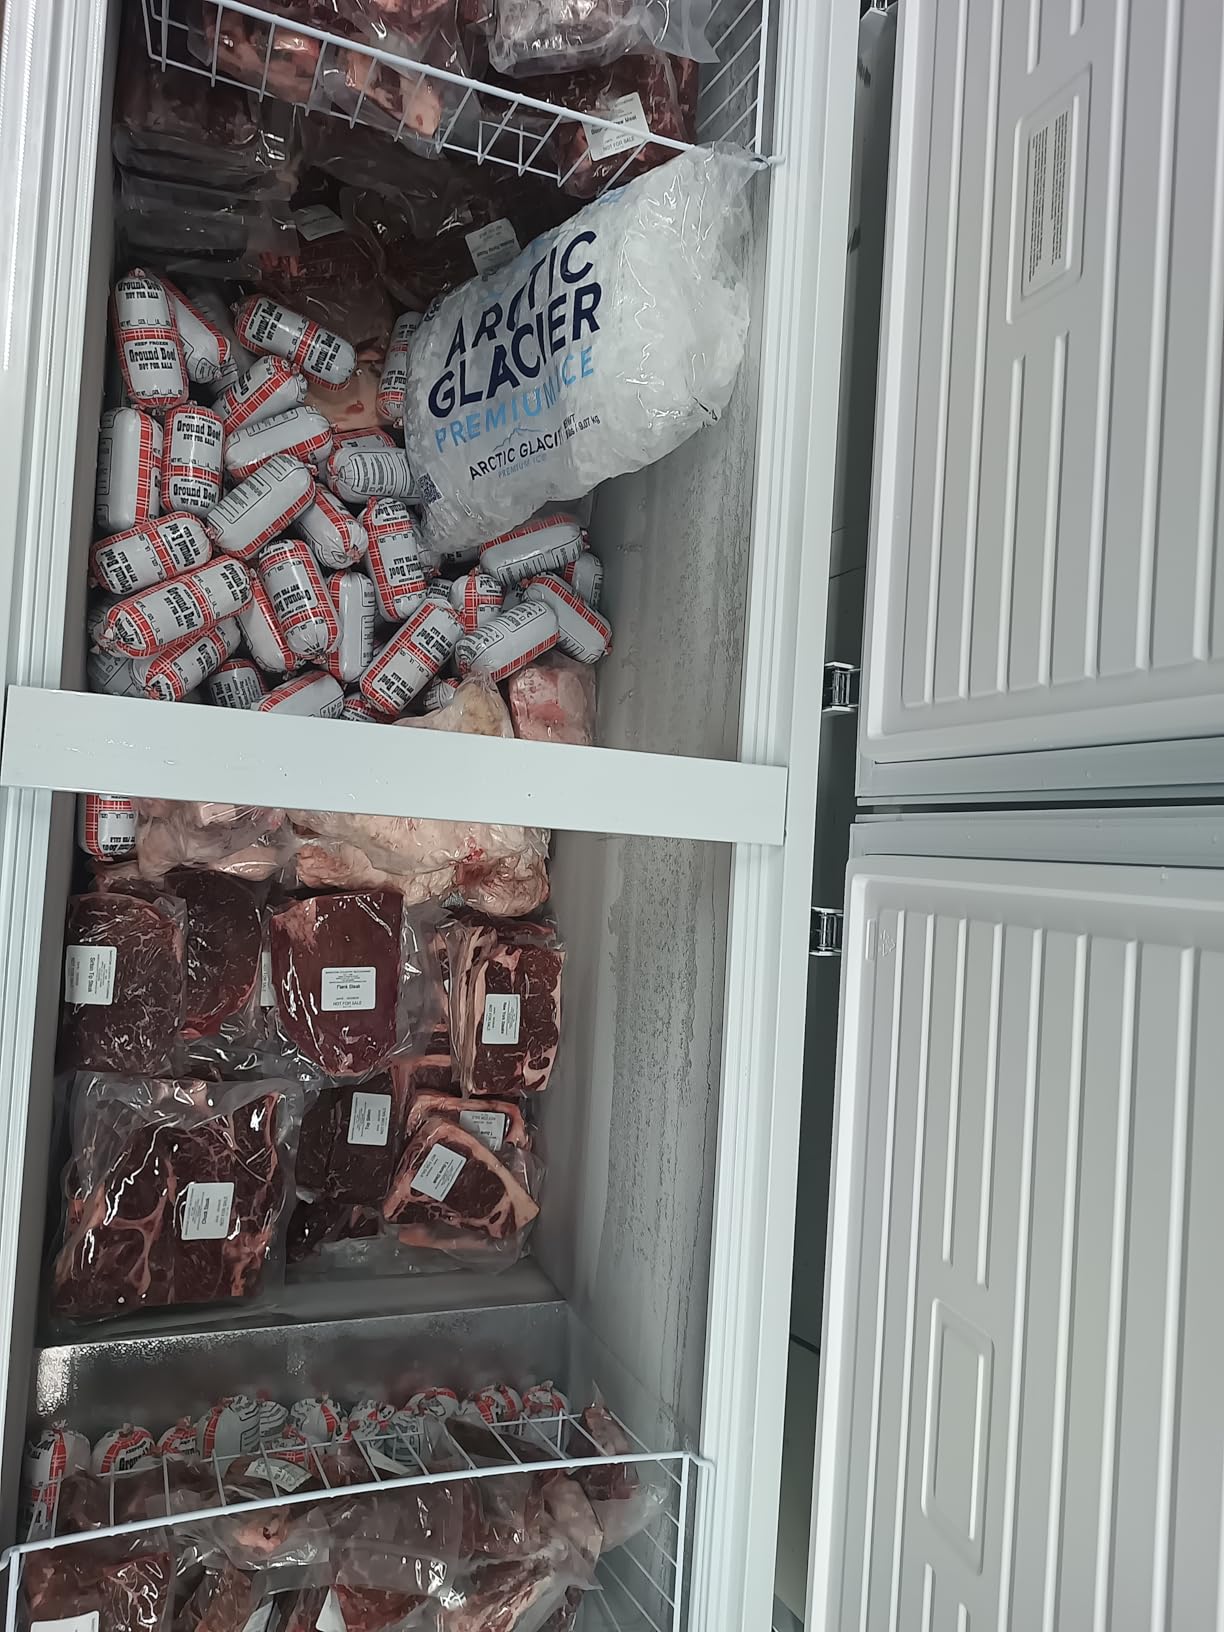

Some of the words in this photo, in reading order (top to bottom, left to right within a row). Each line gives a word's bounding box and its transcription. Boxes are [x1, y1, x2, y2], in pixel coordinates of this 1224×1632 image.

[136, 291, 147, 299] FOR
[147, 290, 159, 299] SALE
[445, 231, 597, 368] ARCTIC
[252, 314, 271, 343] Ground
[262, 301, 278, 317] Beef
[129, 348, 159, 362] Ground
[160, 347, 177, 361] Beef
[311, 347, 328, 373] Ground
[321, 332, 336, 348] Beef
[428, 282, 602, 418] GLACIER
[139, 362, 149, 370] NOT
[435, 374, 555, 453] PREMIUM
[177, 420, 205, 435] Ground
[207, 425, 221, 441] Beef
[183, 433, 193, 441] NOT
[195, 434, 203, 442] FOR
[205, 436, 215, 446] SALE
[469, 448, 516, 480] ARCTIC
[173, 483, 201, 498] Ground
[203, 487, 217, 503] Beef
[180, 497, 189, 505] NOT
[190, 498, 198, 506] FOR
[100, 548, 120, 568] Beef
[175, 539, 196, 567] Ground
[110, 565, 133, 593] Ground
[223, 563, 244, 588] Ground
[389, 564, 406, 579] Beef
[166, 586, 191, 614] Ground
[184, 610, 198, 630] Beef
[284, 589, 312, 610] Ground
[164, 597, 172, 607] NOT
[170, 605, 179, 616] FOR
[176, 615, 184, 628] SALE
[416, 628, 434, 645] Beef
[430, 626, 440, 637] SALE
[377, 674, 395, 691] Beef
[391, 672, 402, 683] SALE
